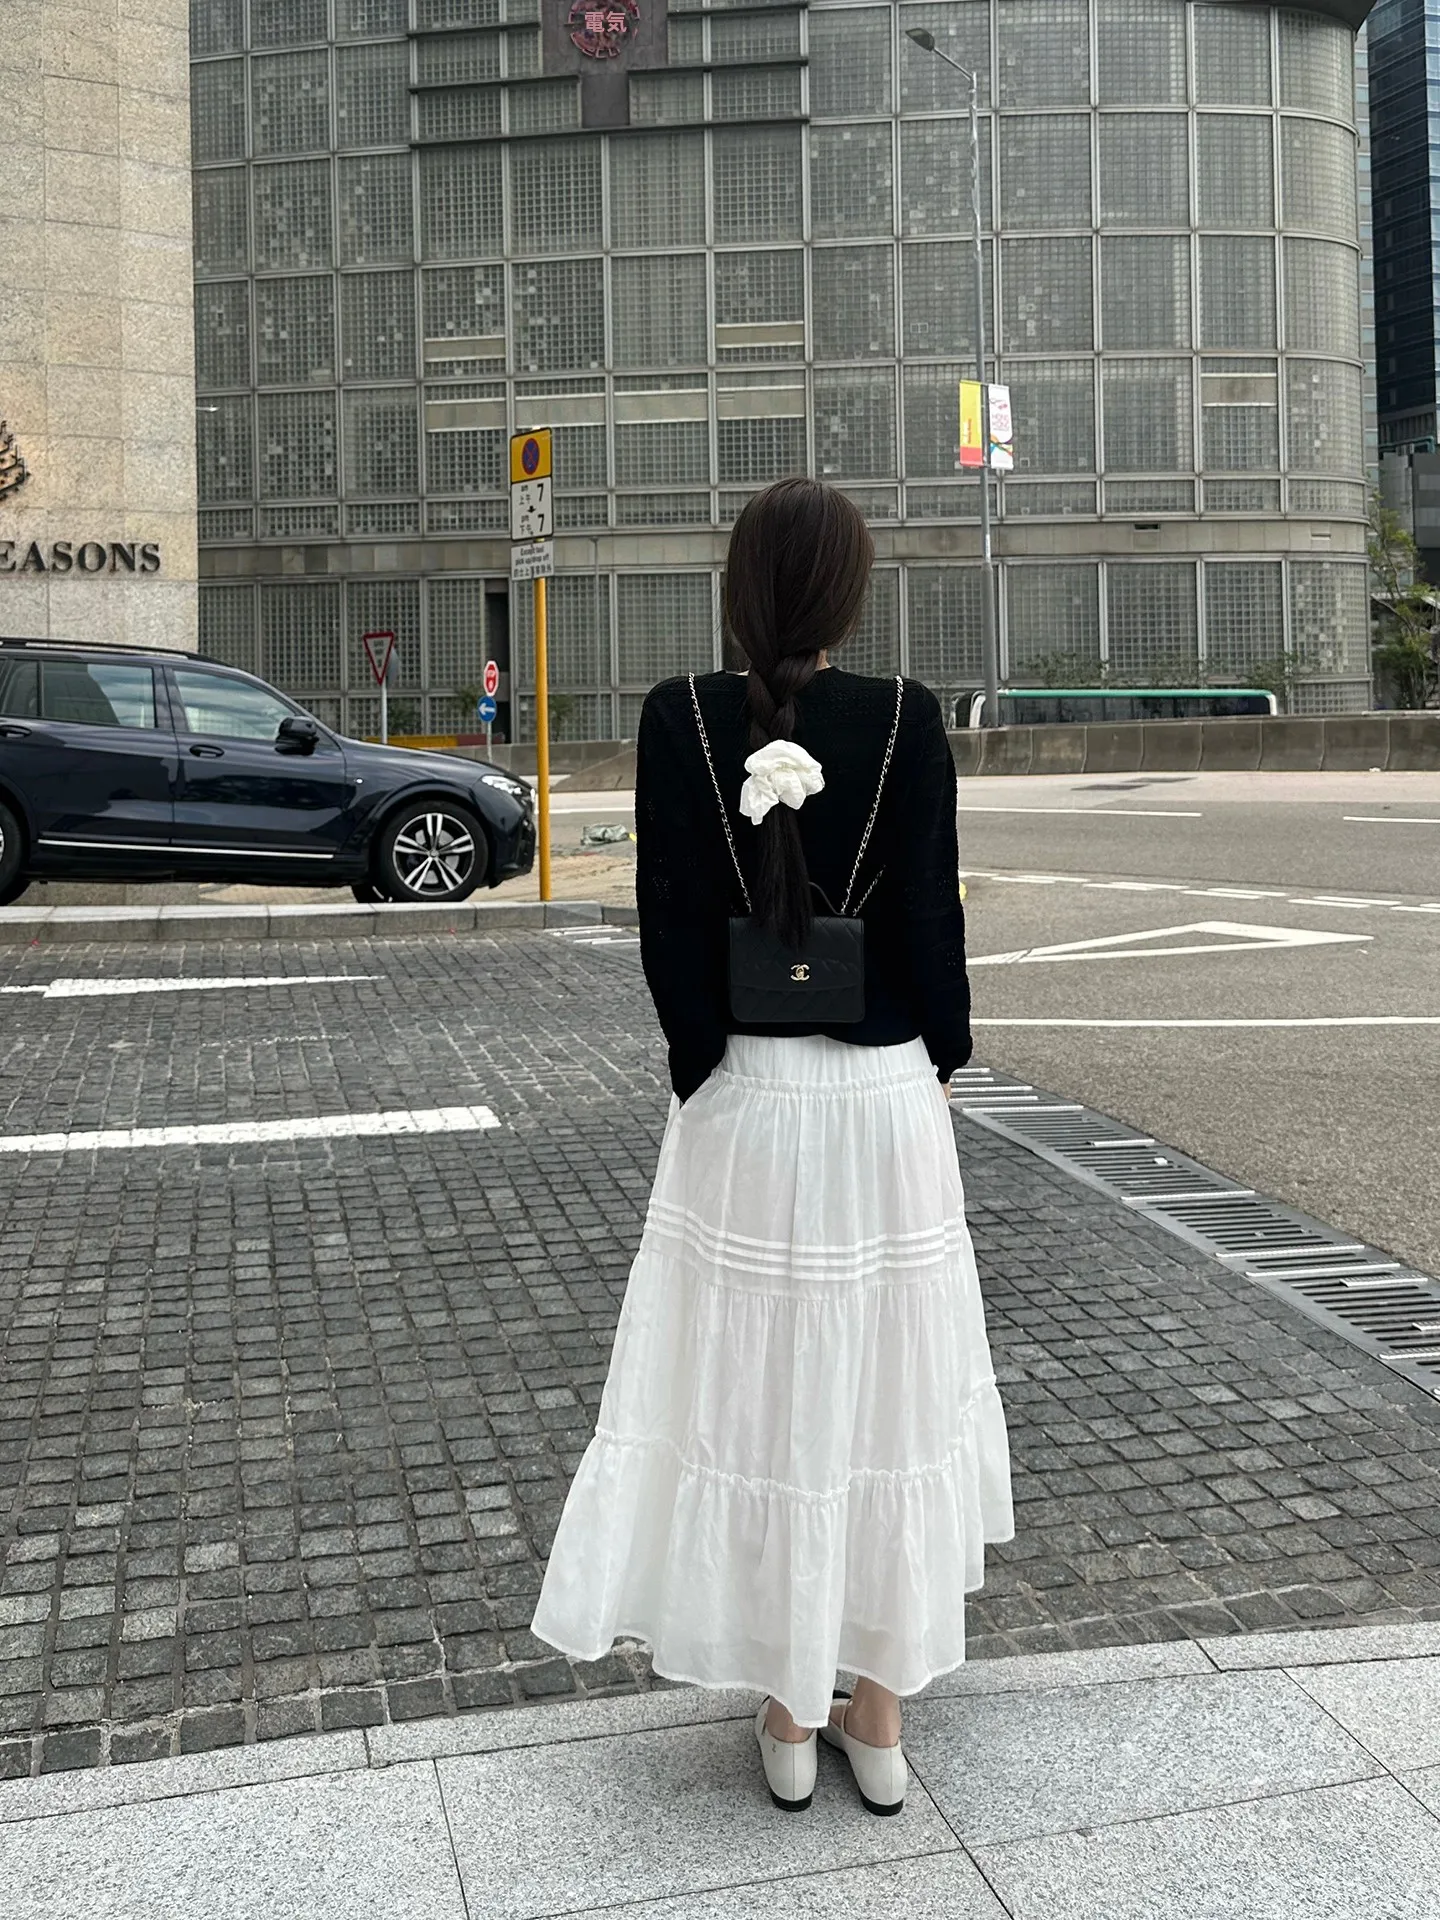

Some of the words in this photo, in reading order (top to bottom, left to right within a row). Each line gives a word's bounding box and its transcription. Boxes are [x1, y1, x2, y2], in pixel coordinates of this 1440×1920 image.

[585, 11, 627, 33] 電気
[537, 483, 544, 502] 7
[538, 513, 545, 532] 7
[0, 541, 161, 572] EASONS
